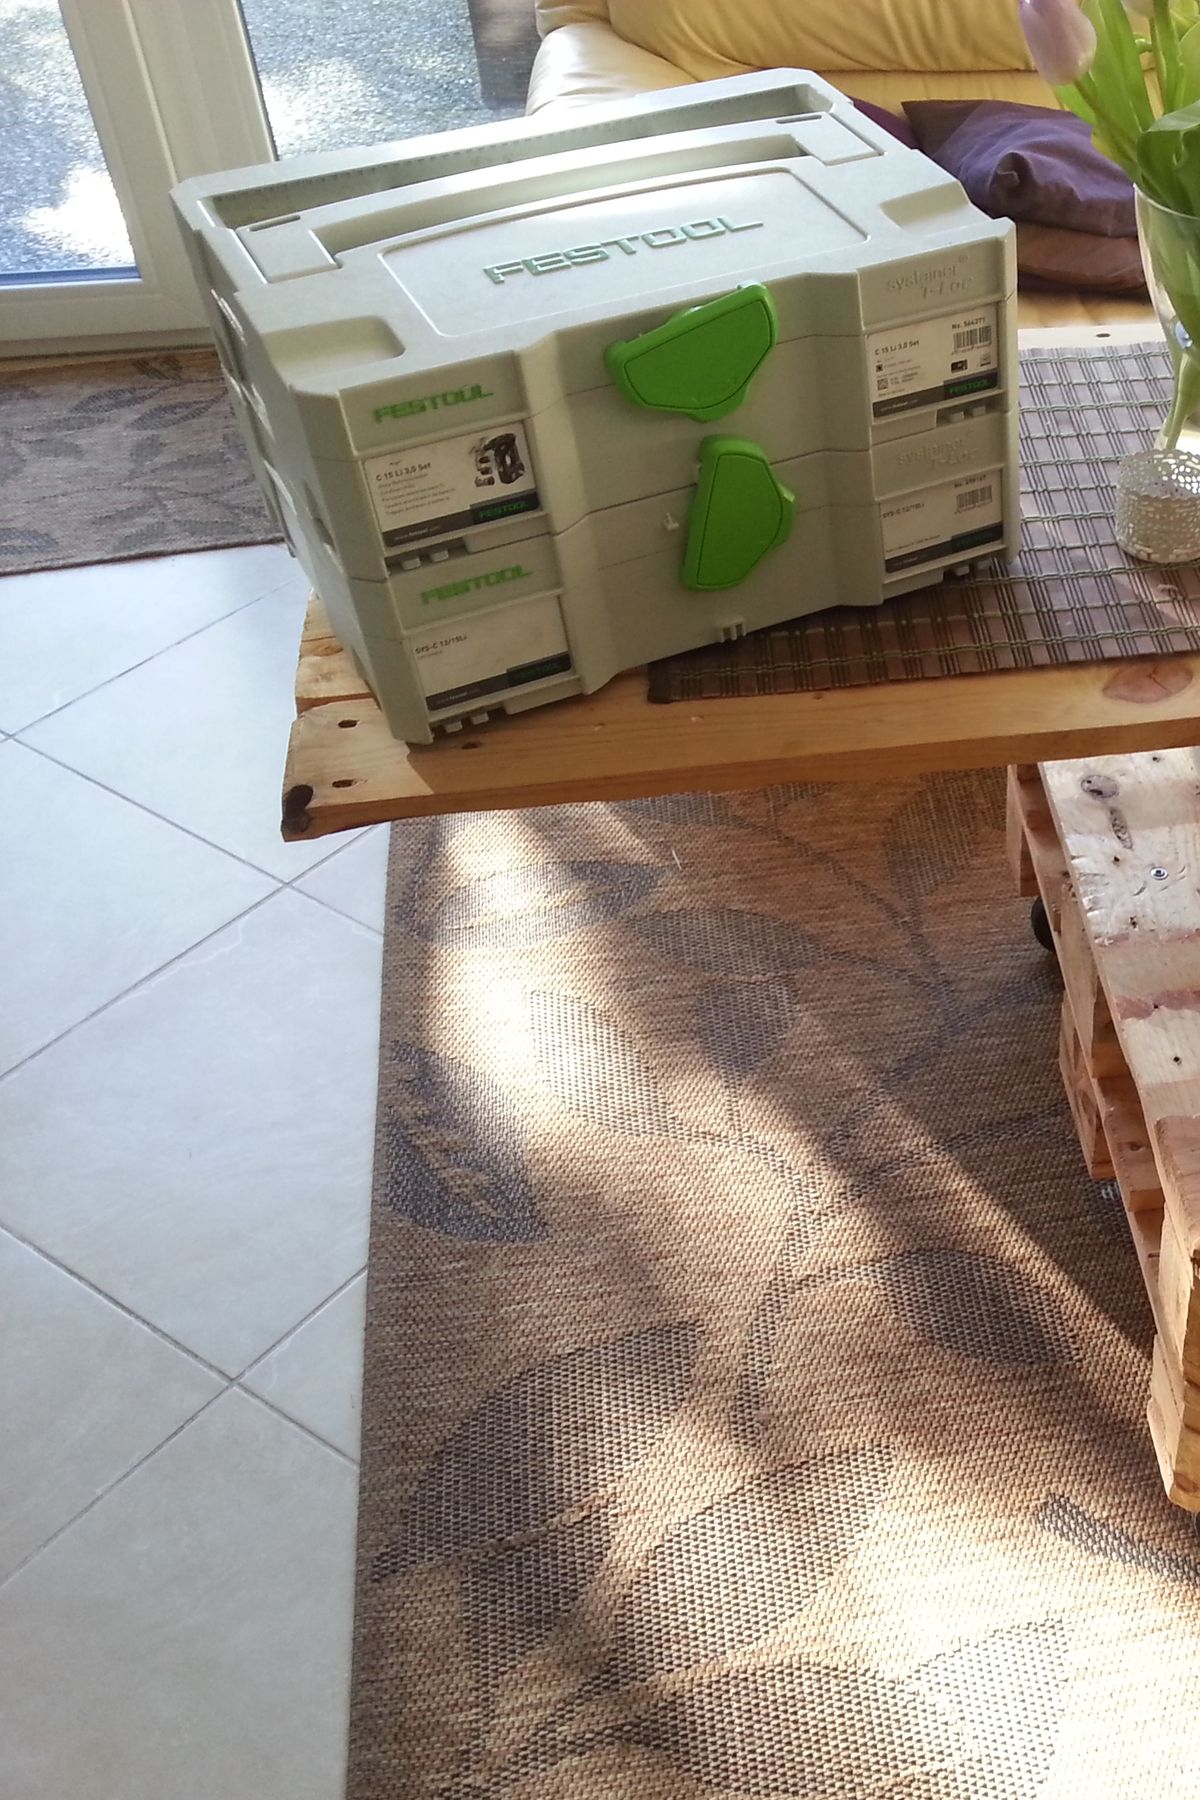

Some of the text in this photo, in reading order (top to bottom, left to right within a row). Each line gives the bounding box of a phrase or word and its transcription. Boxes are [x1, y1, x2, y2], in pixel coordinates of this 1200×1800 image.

[483, 215, 764, 285] FESTOOL
[373, 383, 495, 424] FESTOOL
[478, 501, 529, 519] FESTOOL
[420, 564, 535, 606] FESTOOL
